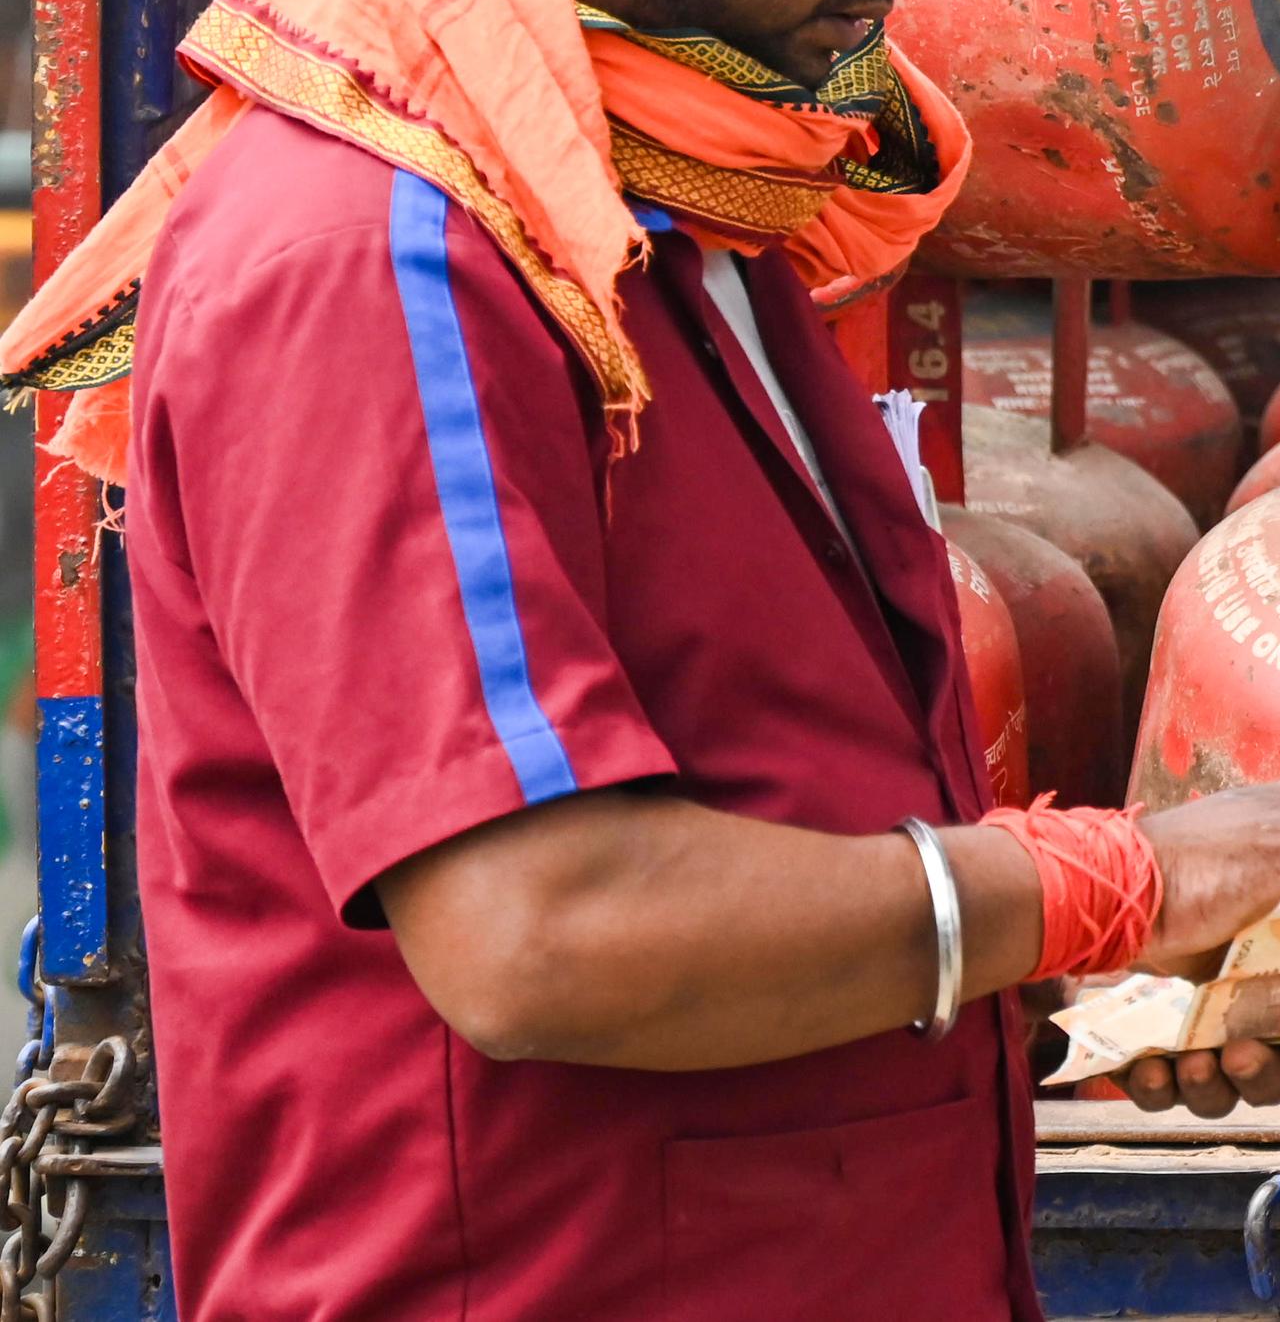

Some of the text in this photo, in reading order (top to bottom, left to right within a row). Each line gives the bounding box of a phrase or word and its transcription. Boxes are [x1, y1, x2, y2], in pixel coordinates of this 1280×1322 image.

[1171, 33, 1193, 73] OFF
[1131, 81, 1151, 118] USE
[1213, 589, 1263, 645] USE
